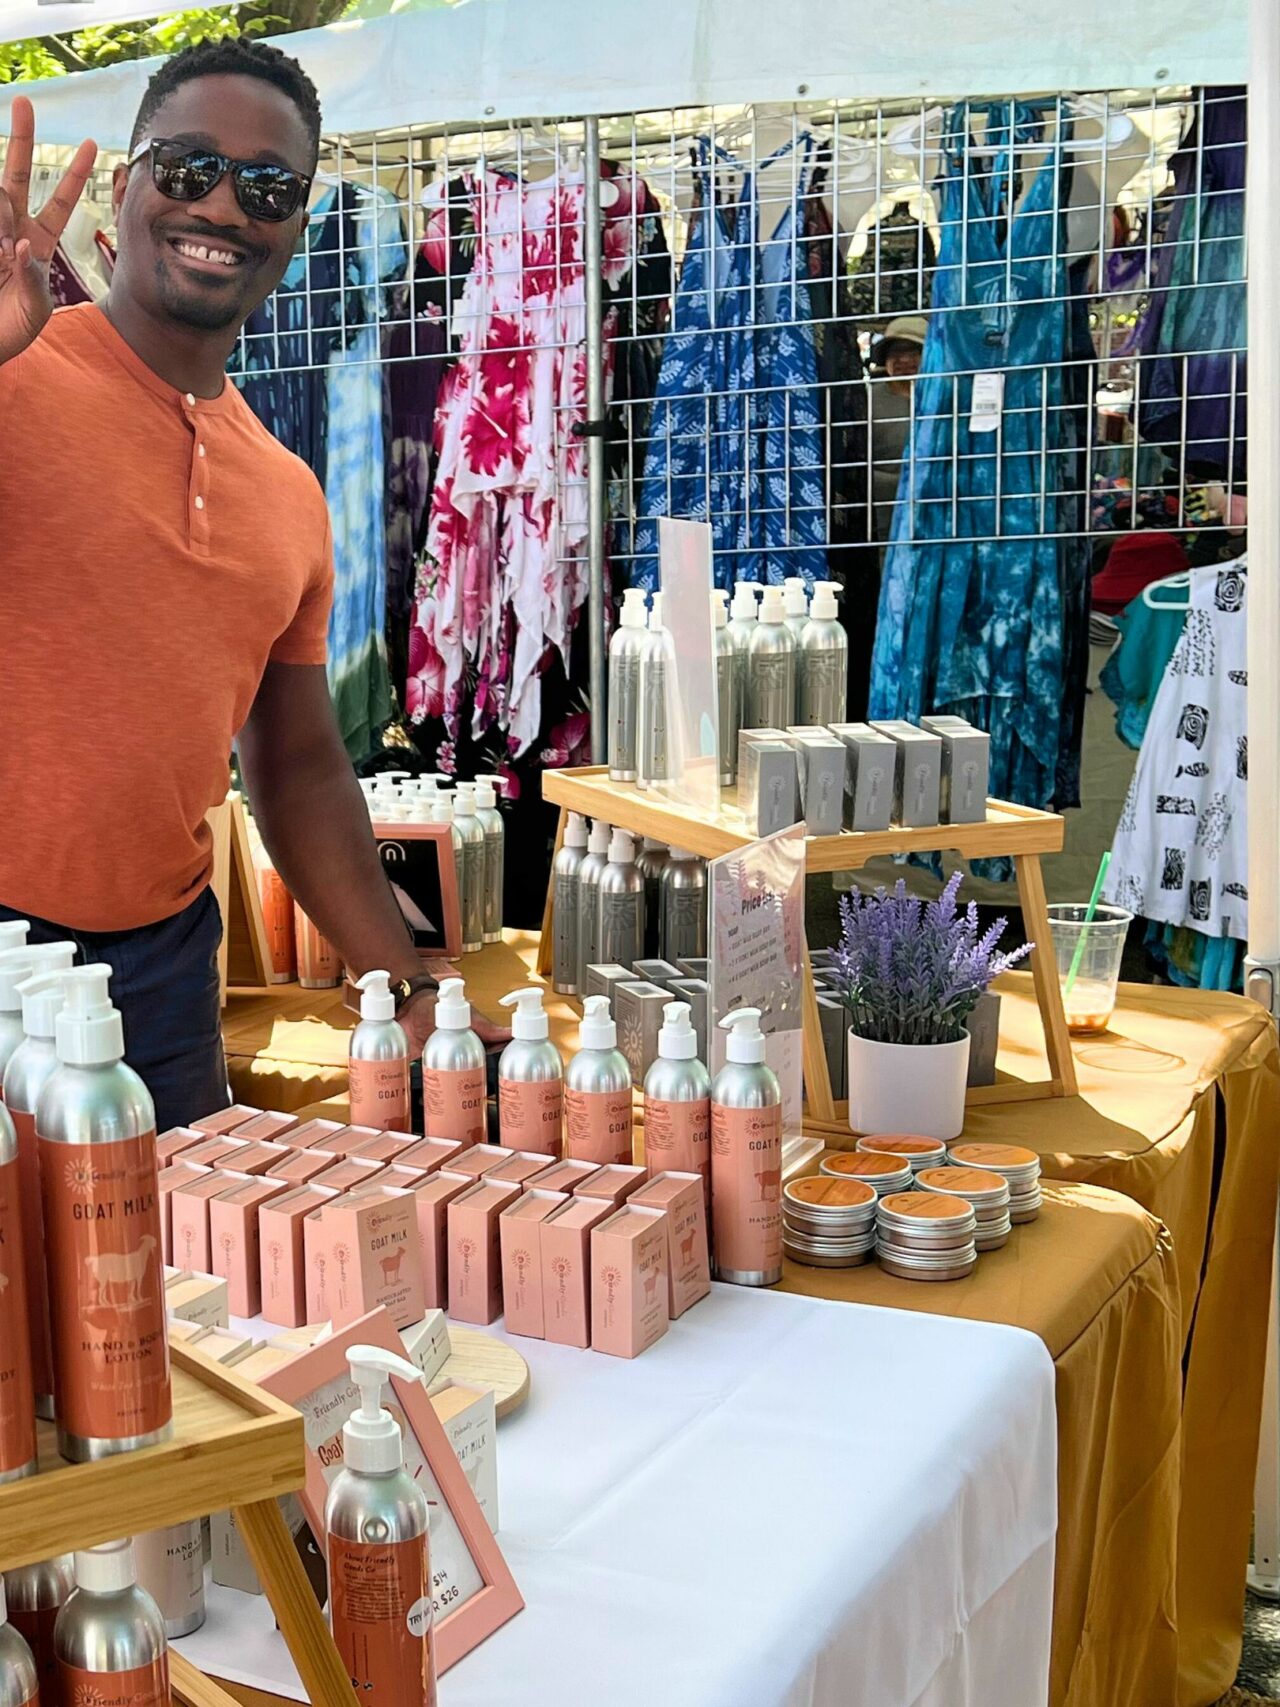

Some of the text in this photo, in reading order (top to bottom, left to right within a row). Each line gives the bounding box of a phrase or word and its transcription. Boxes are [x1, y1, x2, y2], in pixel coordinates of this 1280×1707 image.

[378, 1089, 399, 1099] GOAT
[609, 1121, 629, 1134] GOAT
[693, 1131, 711, 1143] GOA
[749, 1140, 771, 1151] GOAT
[73, 1201, 115, 1219] GOAT
[371, 1229, 408, 1251] GOAT MILK
[81, 1341, 123, 1351] HAND
[105, 1348, 152, 1364] LOTION
[314, 1392, 345, 1419] Friendly
[471, 1434, 486, 1454] MILK
[167, 1542, 193, 1556] HAND
[433, 1570, 447, 1587] $14
[440, 1585, 460, 1605] $26
[409, 1614, 423, 1626] TRY
